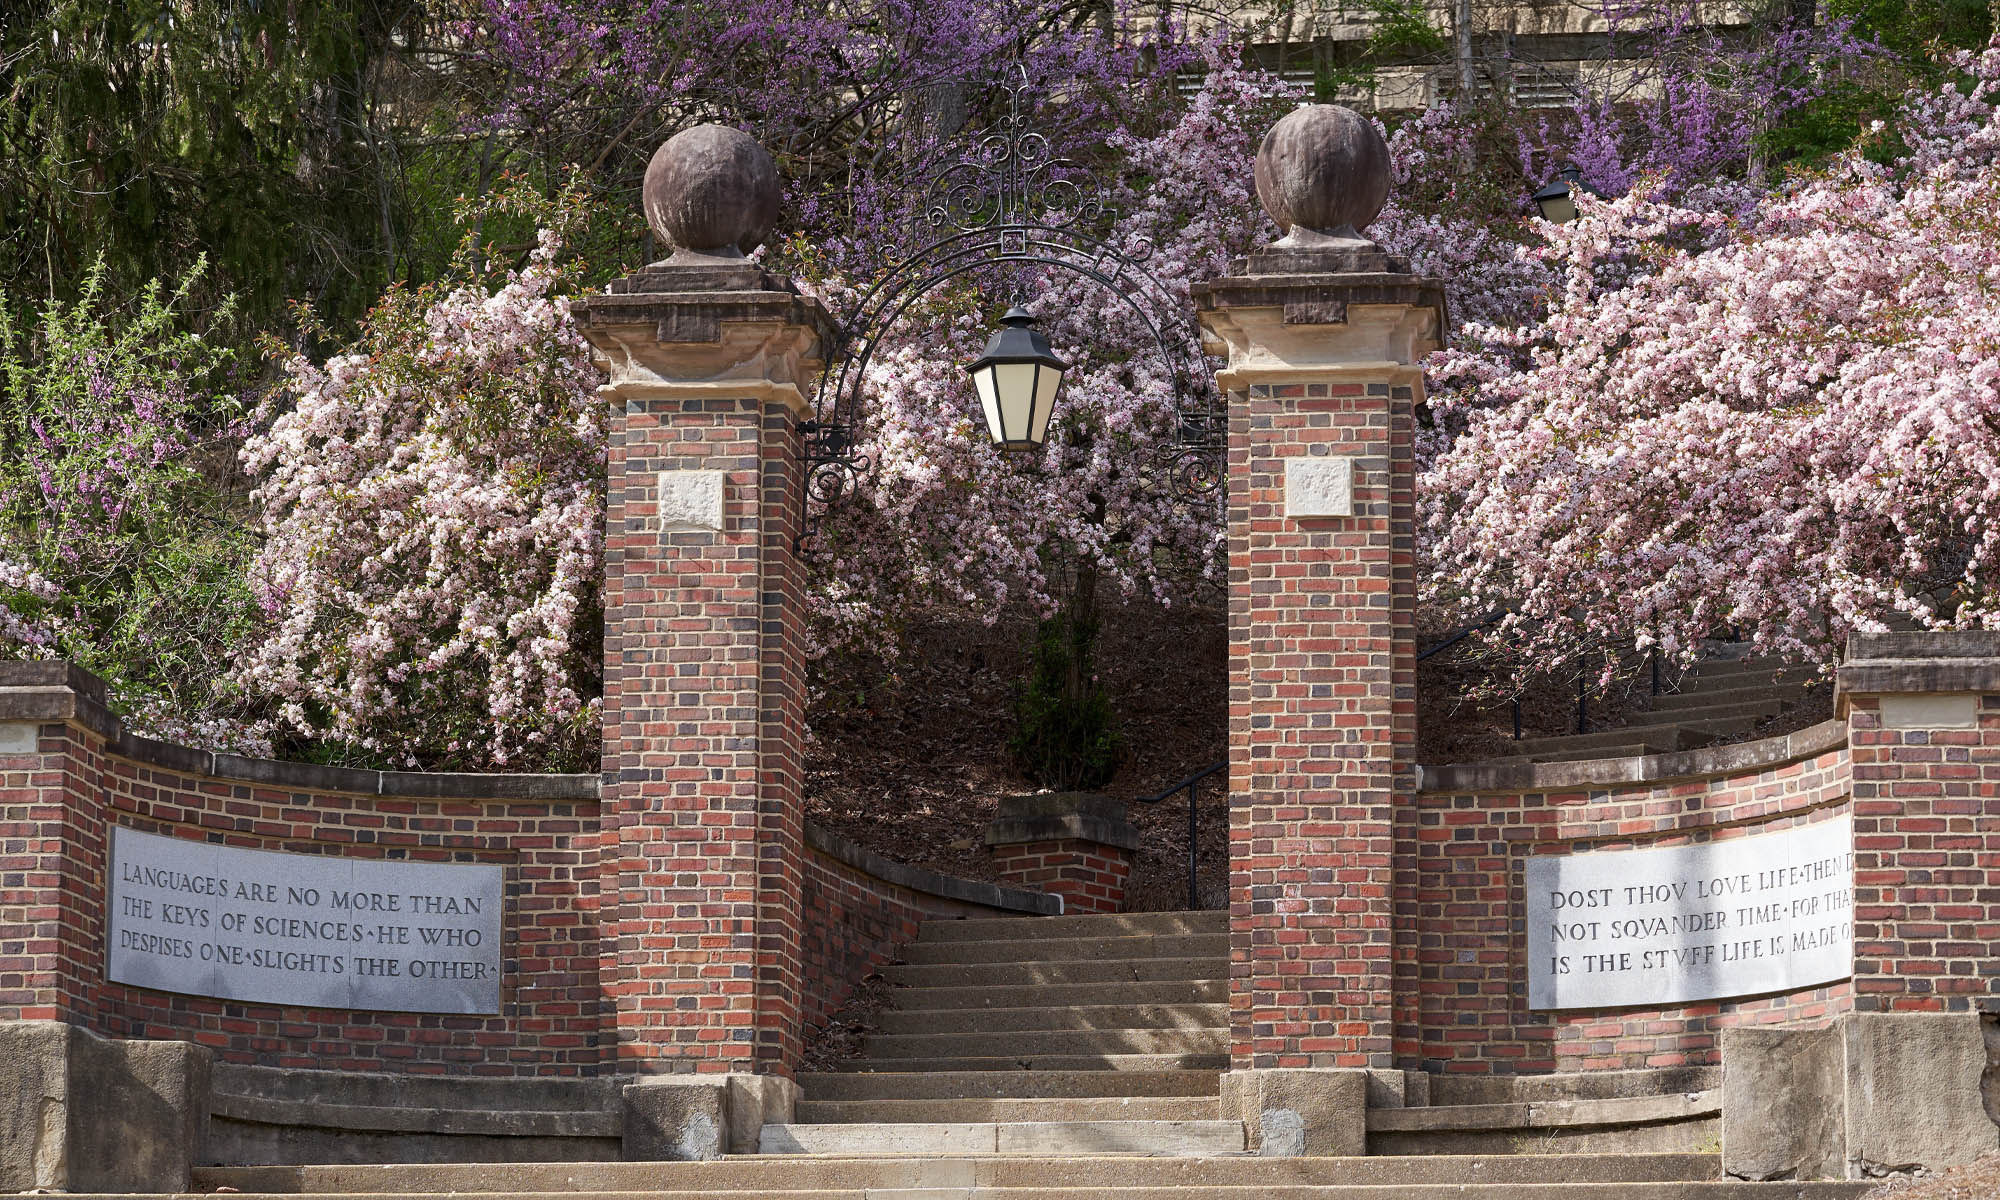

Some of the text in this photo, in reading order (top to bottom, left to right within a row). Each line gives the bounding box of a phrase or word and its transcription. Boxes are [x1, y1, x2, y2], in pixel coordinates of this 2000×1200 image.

[122, 862, 483, 915] LANGUAGES ARE NO MORE THAN
[1550, 888, 1613, 910] DOST
[1624, 882, 1688, 905] THOV
[1698, 875, 1752, 900] LOVE
[1759, 866, 1799, 894] LIFE
[1803, 856, 1841, 882] THEN
[121, 896, 153, 920] THE
[162, 903, 210, 928] KEYS
[221, 912, 247, 933] OF
[377, 925, 410, 944] HE
[418, 927, 482, 947] WHO
[1550, 888, 1852, 943] NOT SQVANDER TIME FOR THA
[121, 929, 193, 959] DESPISES
[252, 949, 345, 974] SLIGHTS
[354, 957, 400, 977] THE
[408, 960, 488, 980] OTHER
[1550, 955, 1570, 975] IS
[1583, 952, 1632, 974] THE
[1643, 945, 1715, 970] STVFF
[1722, 938, 1763, 963] LIFE
[1769, 935, 1785, 956] IS
[1792, 926, 1837, 952] MADE
